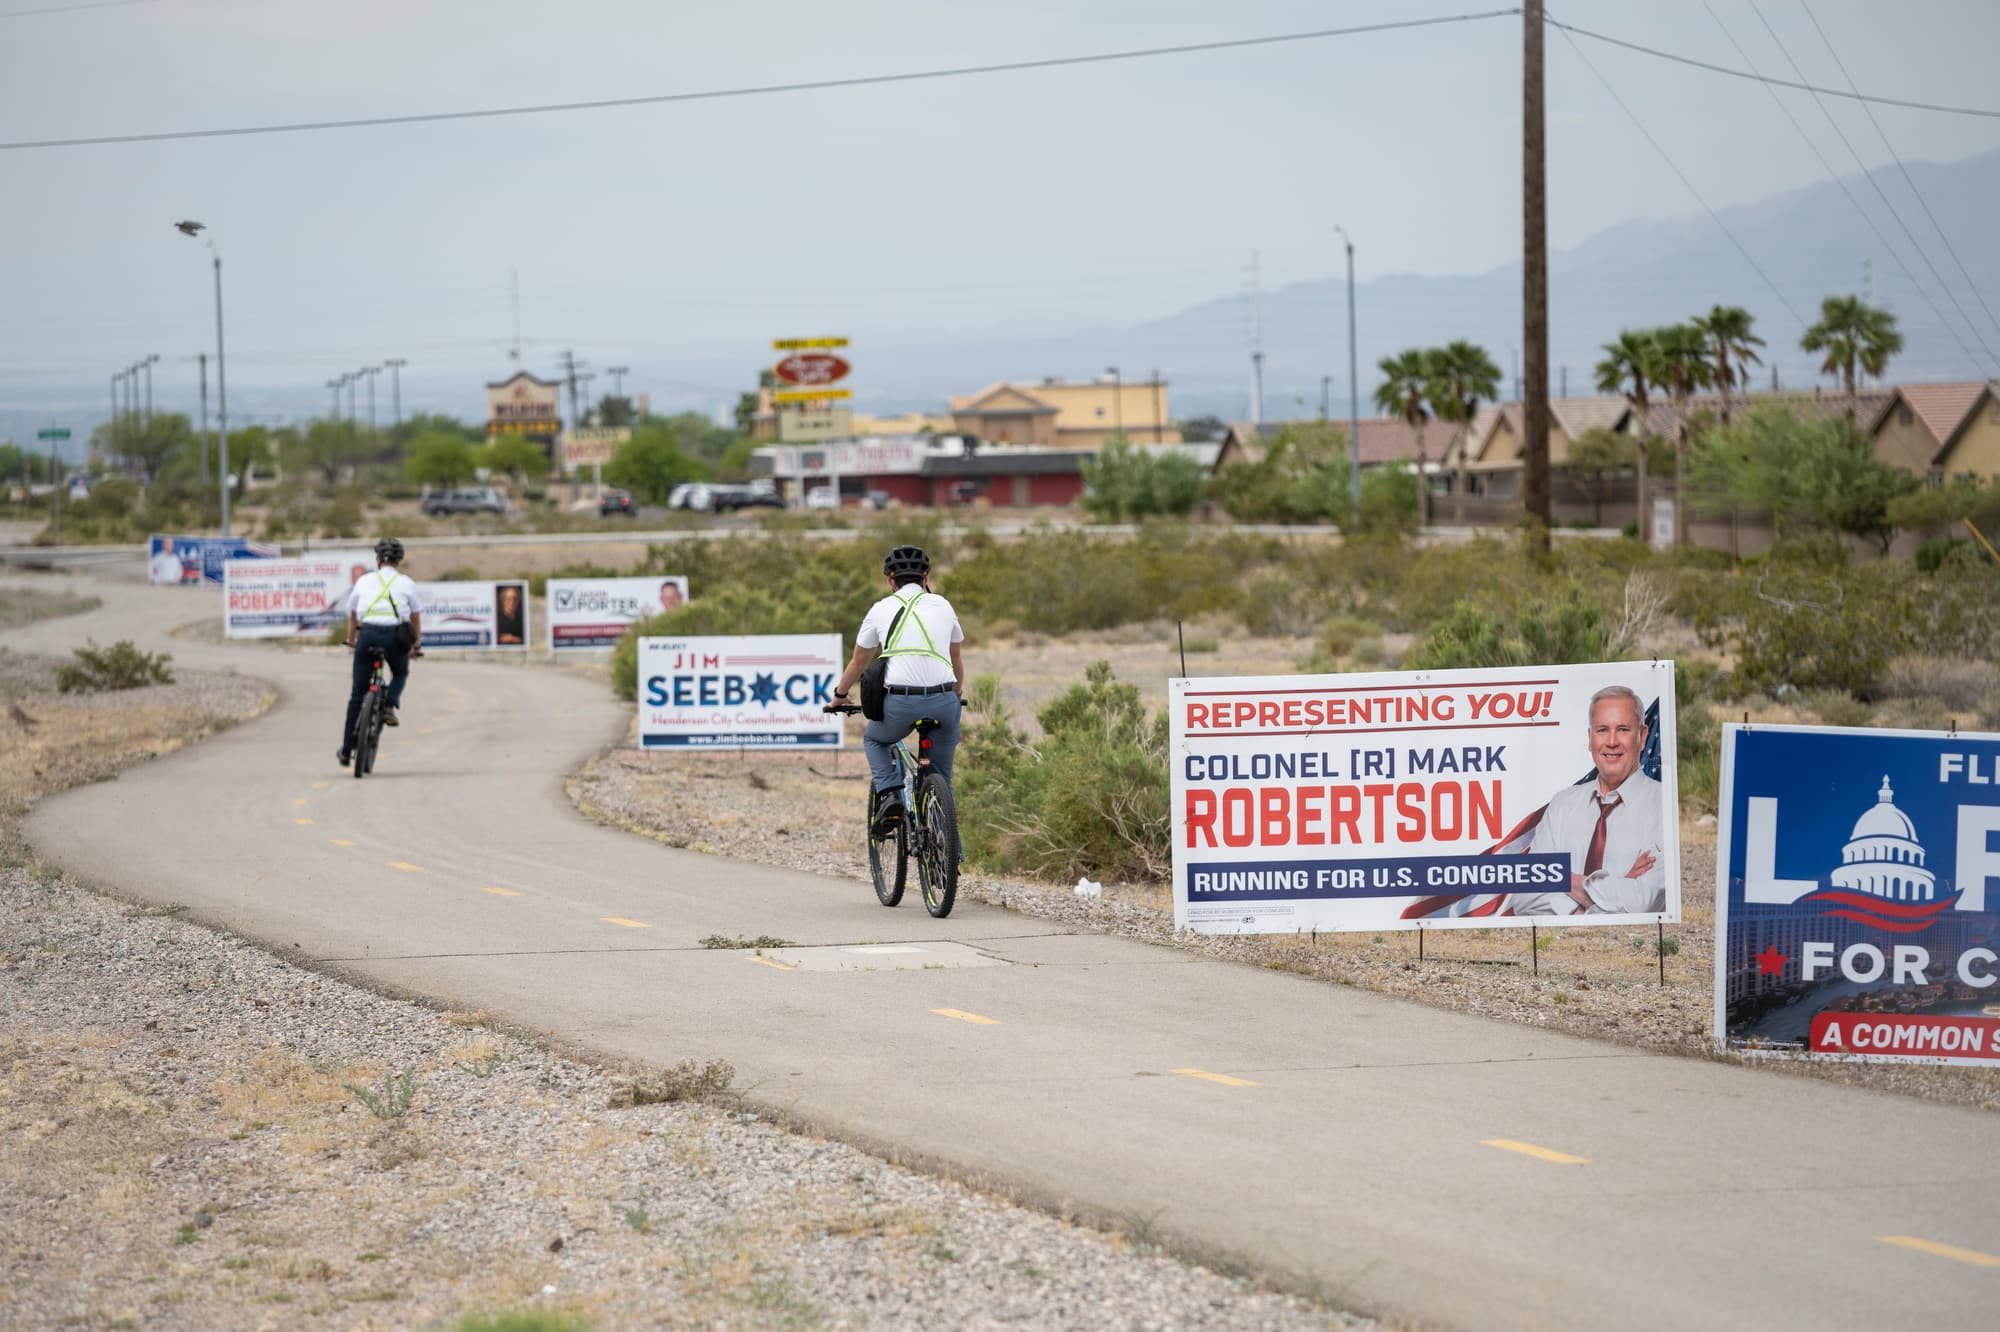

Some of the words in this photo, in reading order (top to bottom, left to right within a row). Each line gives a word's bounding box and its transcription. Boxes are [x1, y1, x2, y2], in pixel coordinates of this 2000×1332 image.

[229, 591, 328, 611] ROBERTSON
[578, 598, 638, 611] PORTER
[674, 653, 719, 669] JIM
[652, 712, 708, 726] Henderson
[711, 711, 732, 727] City
[735, 710, 795, 726] Councilman
[799, 711, 825, 725] Ward
[1187, 695, 1455, 728] REPRESENTING
[1467, 691, 1553, 720] YOU!
[1185, 752, 1339, 781] COLONEL
[1351, 747, 1395, 780] [R]
[1408, 745, 1507, 775] MARK
[1185, 779, 1503, 848] ROBERTSON
[1194, 870, 1309, 892] RUNNING
[1316, 868, 1365, 889] FOR
[1373, 867, 1419, 887] U.S.
[1427, 863, 1564, 885] CONGRESS
[1802, 942, 1929, 986] FOR
[1956, 948, 1998, 989] C
[1820, 1022, 1843, 1047] A
[1852, 1023, 1984, 1051] COMMON
